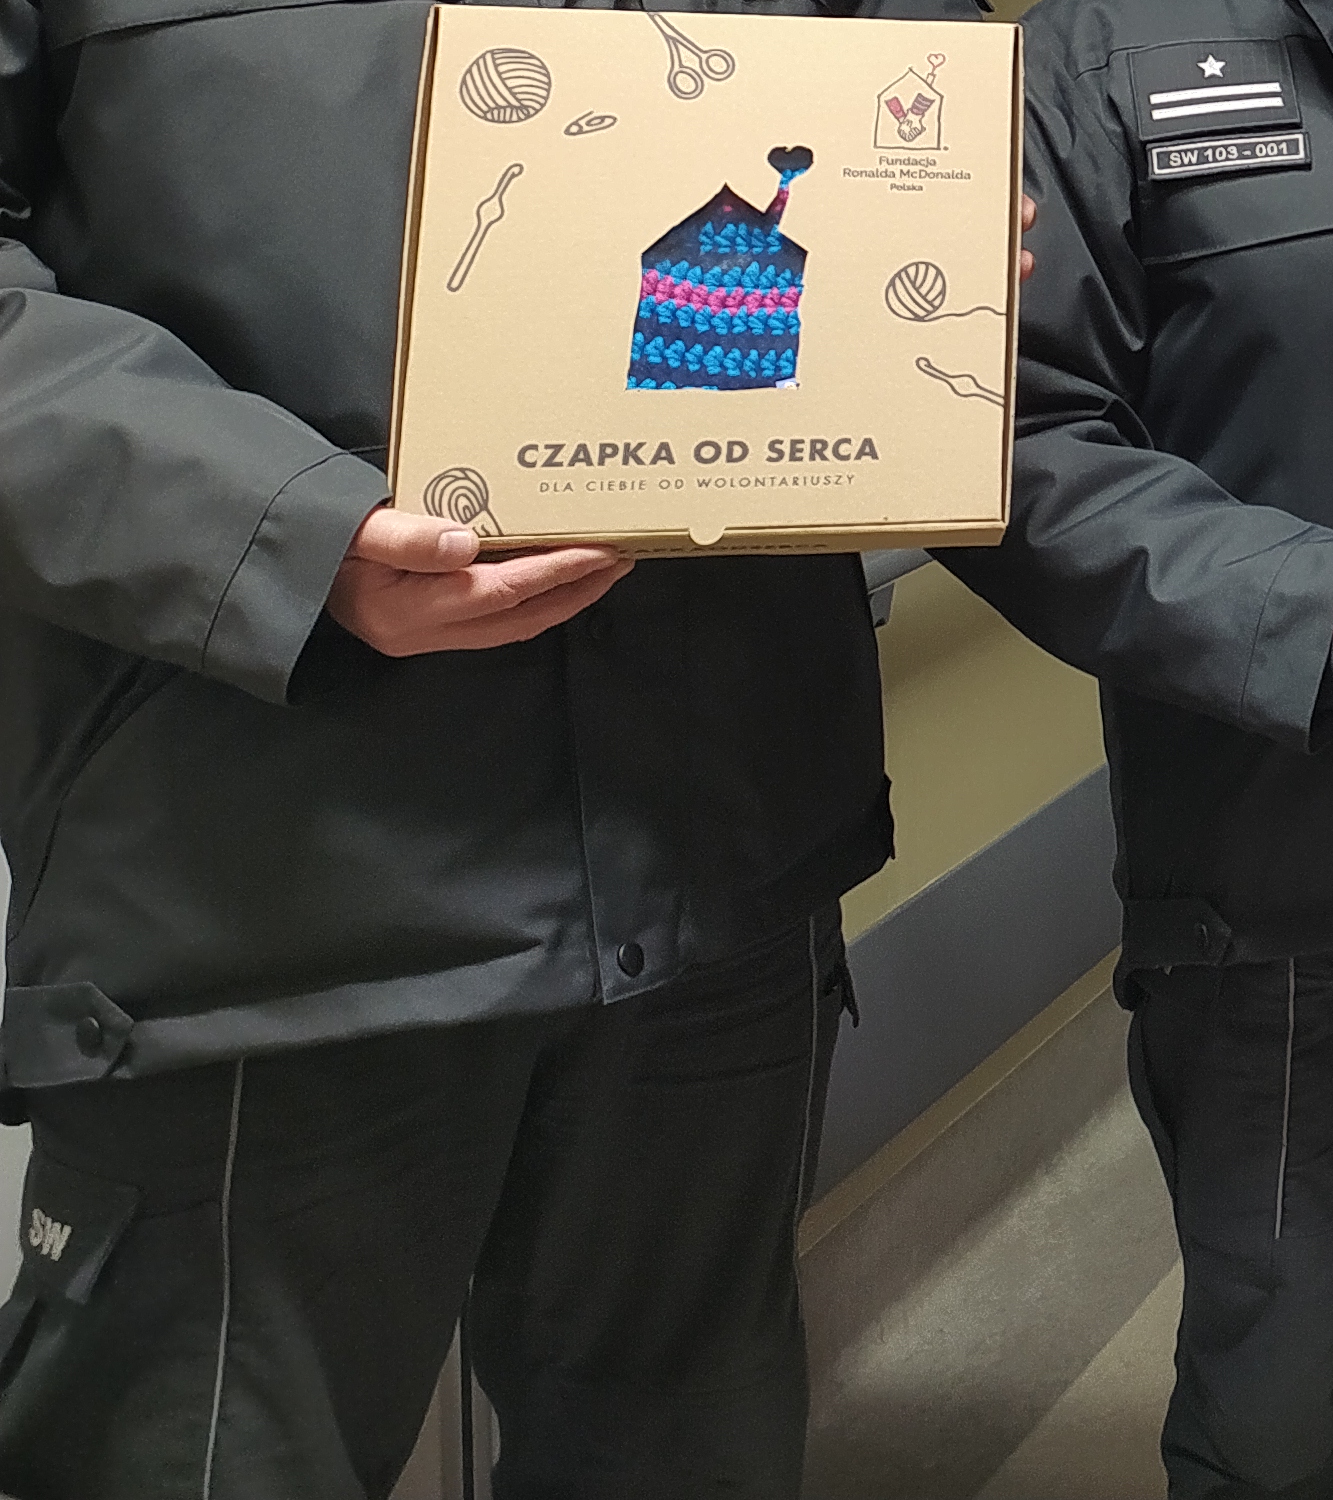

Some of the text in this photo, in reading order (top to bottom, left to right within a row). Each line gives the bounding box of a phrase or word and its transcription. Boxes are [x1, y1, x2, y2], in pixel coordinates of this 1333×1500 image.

[879, 156, 937, 167] Fundacja
[1169, 151, 1198, 167] SW
[1204, 146, 1238, 162] 103
[1256, 142, 1289, 157] 001
[843, 168, 971, 180] Ronalda McDonalda
[890, 183, 923, 191] Polska
[517, 438, 879, 468] CZAPKA OD SERCA
[540, 474, 855, 493] DLA CIEBIE OD WOLONTARIUSZY
[29, 1208, 72, 1262] SW
